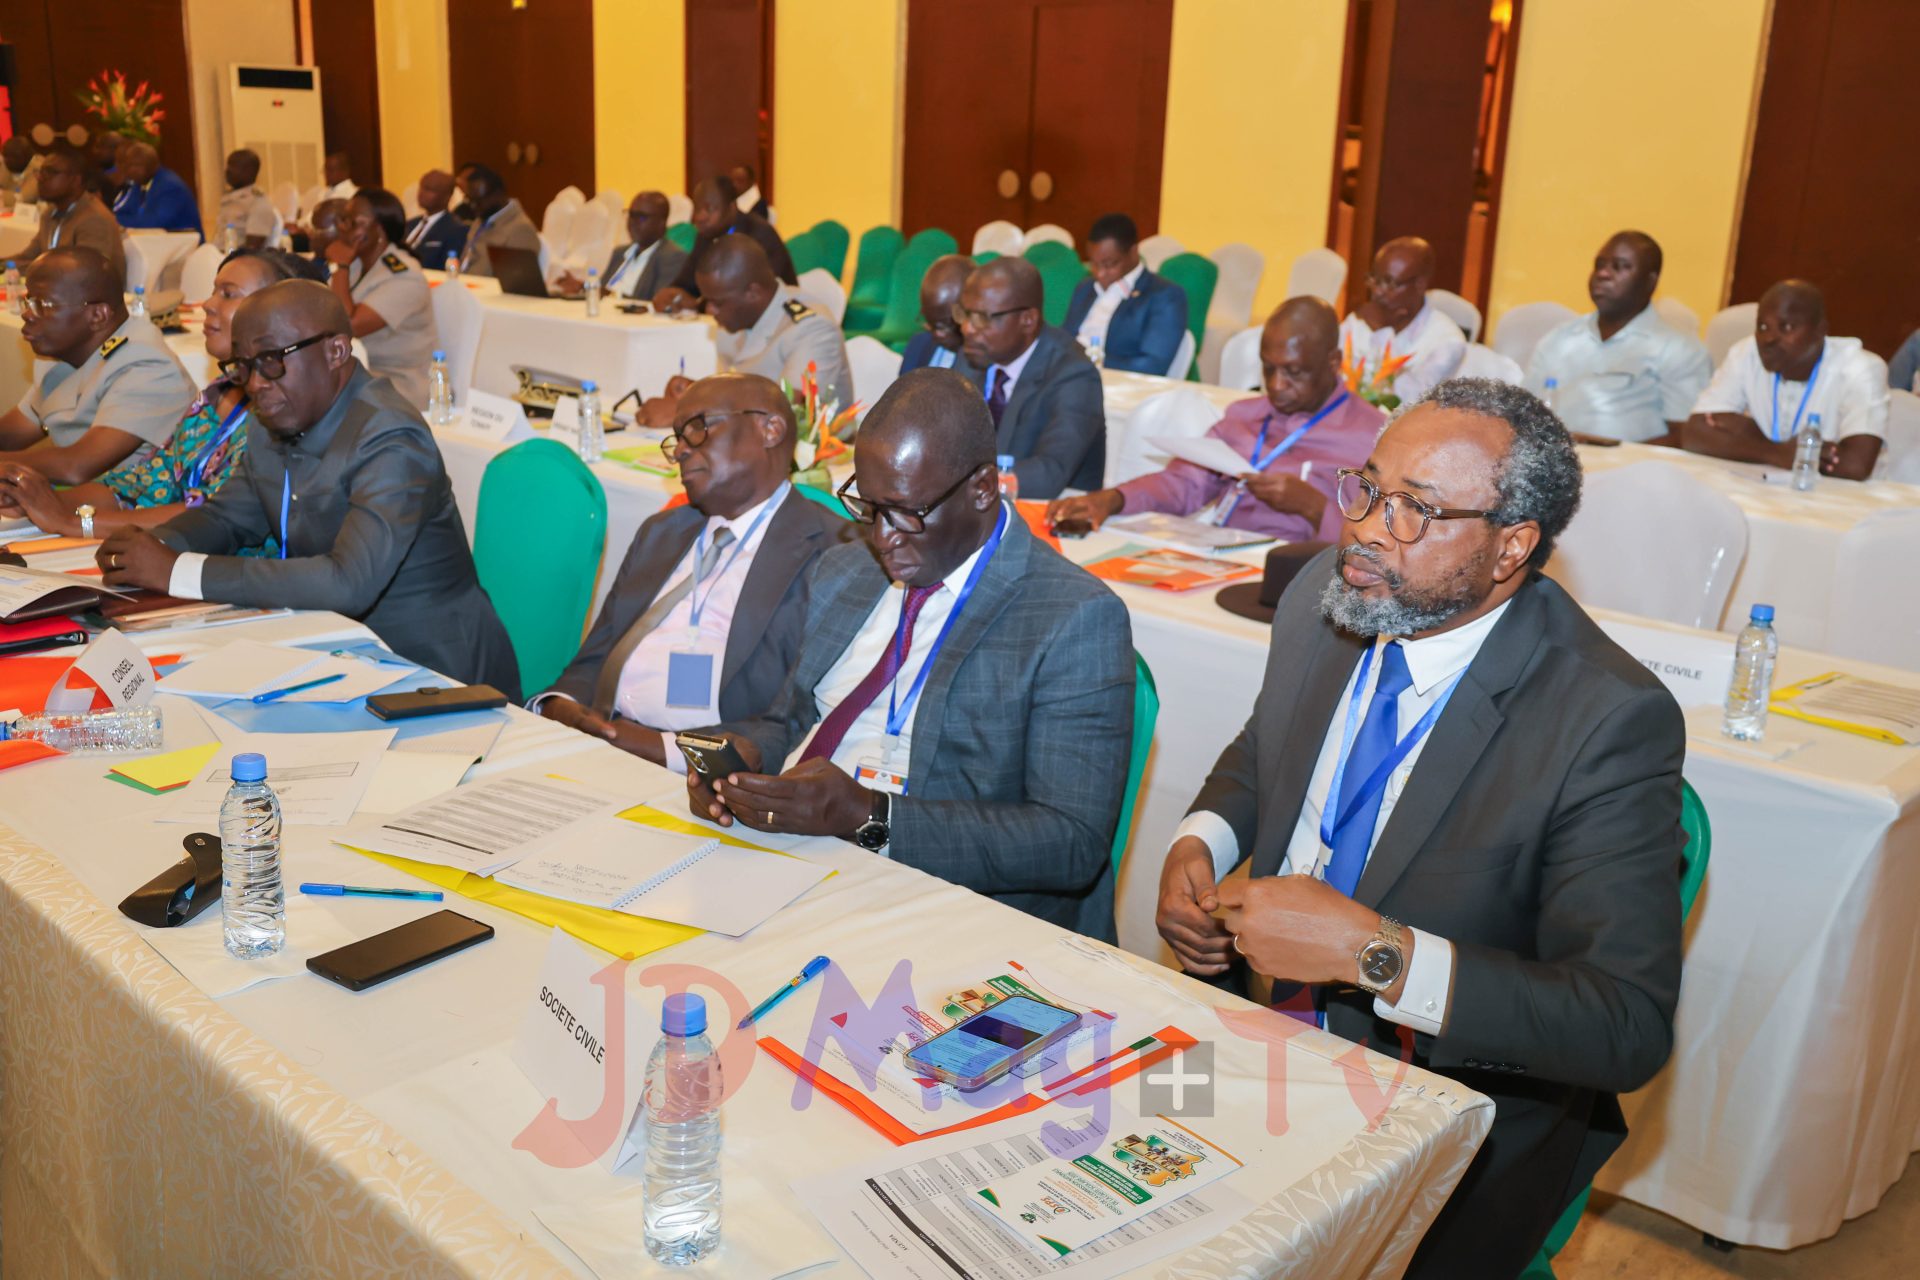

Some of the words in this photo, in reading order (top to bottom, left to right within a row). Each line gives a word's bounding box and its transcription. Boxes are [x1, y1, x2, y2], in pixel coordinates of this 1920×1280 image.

[112, 658, 134, 683] CONSEIL
[1664, 664, 1703, 680] CIVILE
[122, 672, 144, 703] REGIONAL
[540, 986, 576, 1033] SOCIETE
[575, 1025, 605, 1064] CIVILE
